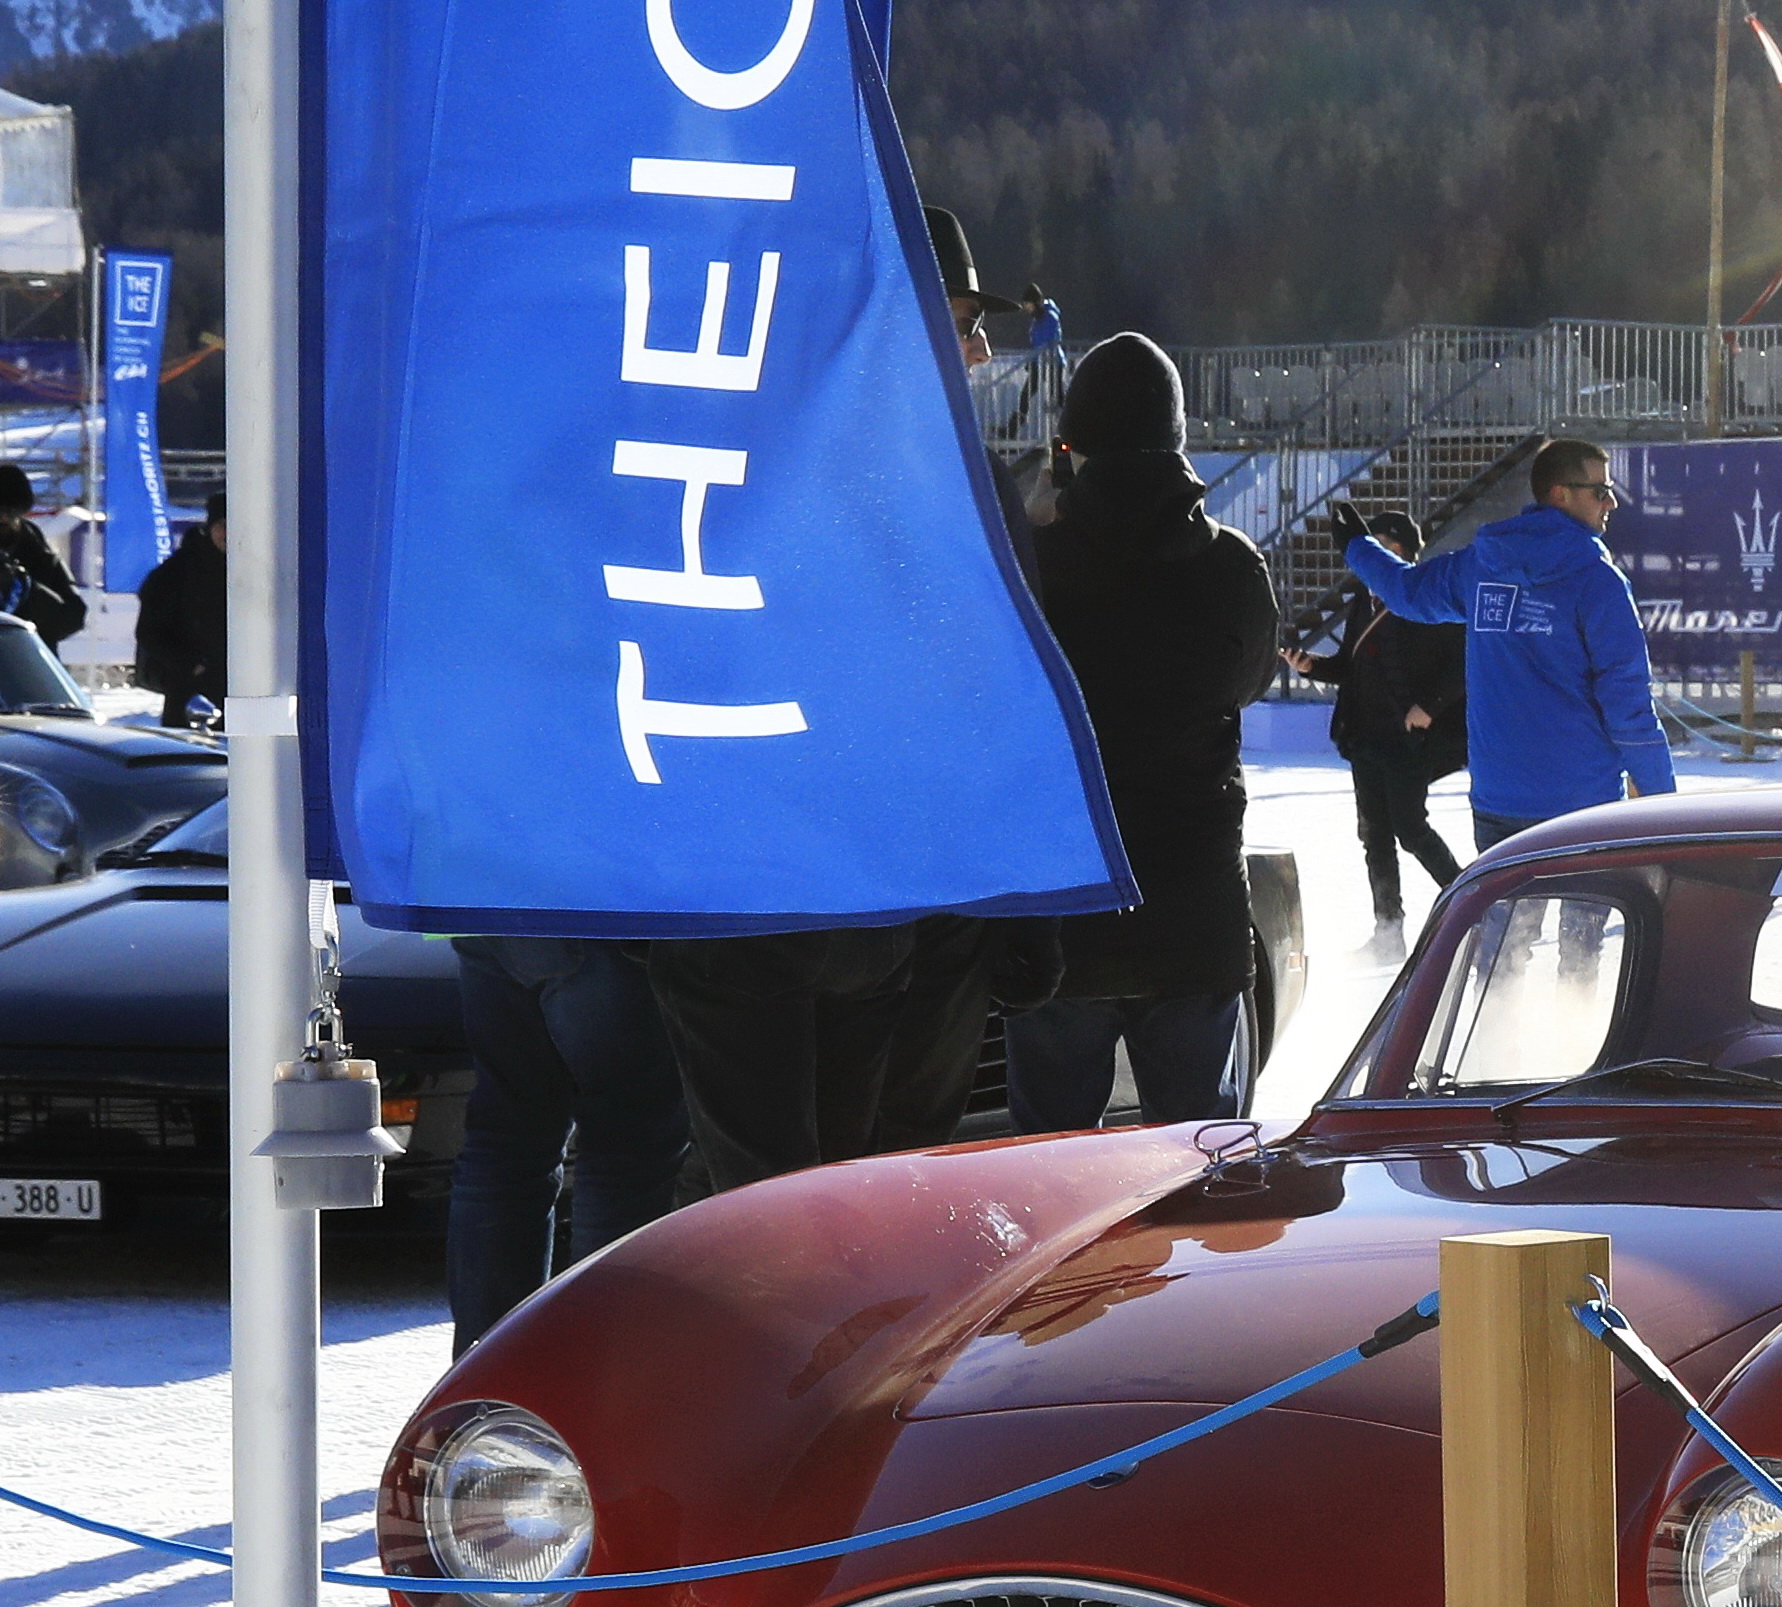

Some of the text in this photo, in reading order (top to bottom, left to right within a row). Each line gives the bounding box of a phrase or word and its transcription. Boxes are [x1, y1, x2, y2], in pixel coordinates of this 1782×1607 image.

[125, 274, 152, 294] THE
[126, 295, 149, 313] ICE
[1483, 593, 1507, 606] THE
[1483, 608, 1503, 622] ICE
[14, 1184, 60, 1213] 388
